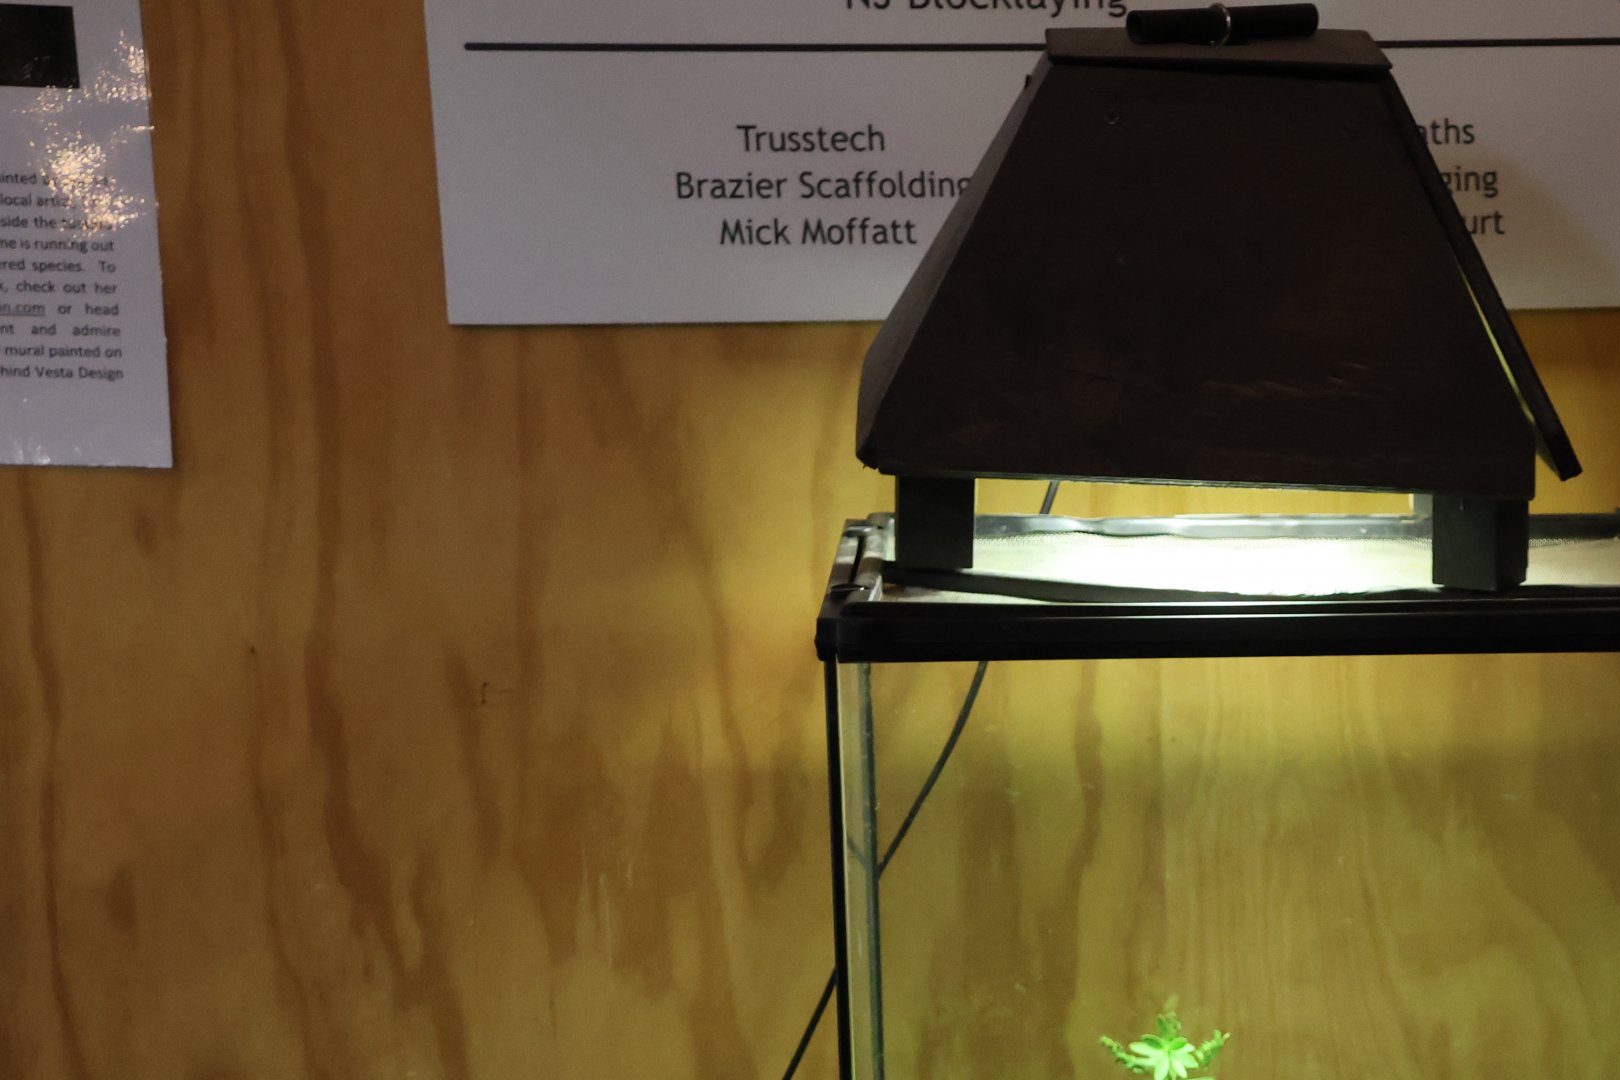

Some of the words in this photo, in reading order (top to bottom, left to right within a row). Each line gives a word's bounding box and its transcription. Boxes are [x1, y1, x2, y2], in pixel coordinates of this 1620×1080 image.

[736, 123, 886, 152] Trusstech
[0, 172, 37, 185] inted
[675, 171, 788, 199] Brazier
[34, 216, 57, 229] the
[719, 217, 792, 246] Mick
[800, 216, 918, 245] Moffatt
[91, 241, 115, 252] out
[98, 260, 117, 274] To
[16, 279, 56, 294] check
[63, 282, 88, 294] out
[94, 281, 118, 295] her
[57, 304, 73, 315] or
[84, 302, 120, 316] head
[31, 322, 57, 336] and
[72, 323, 121, 337] admire
[5, 344, 45, 357] mural
[49, 345, 102, 359] painted
[104, 348, 123, 359] on
[34, 365, 74, 379] Vesta
[78, 366, 125, 383] Design
